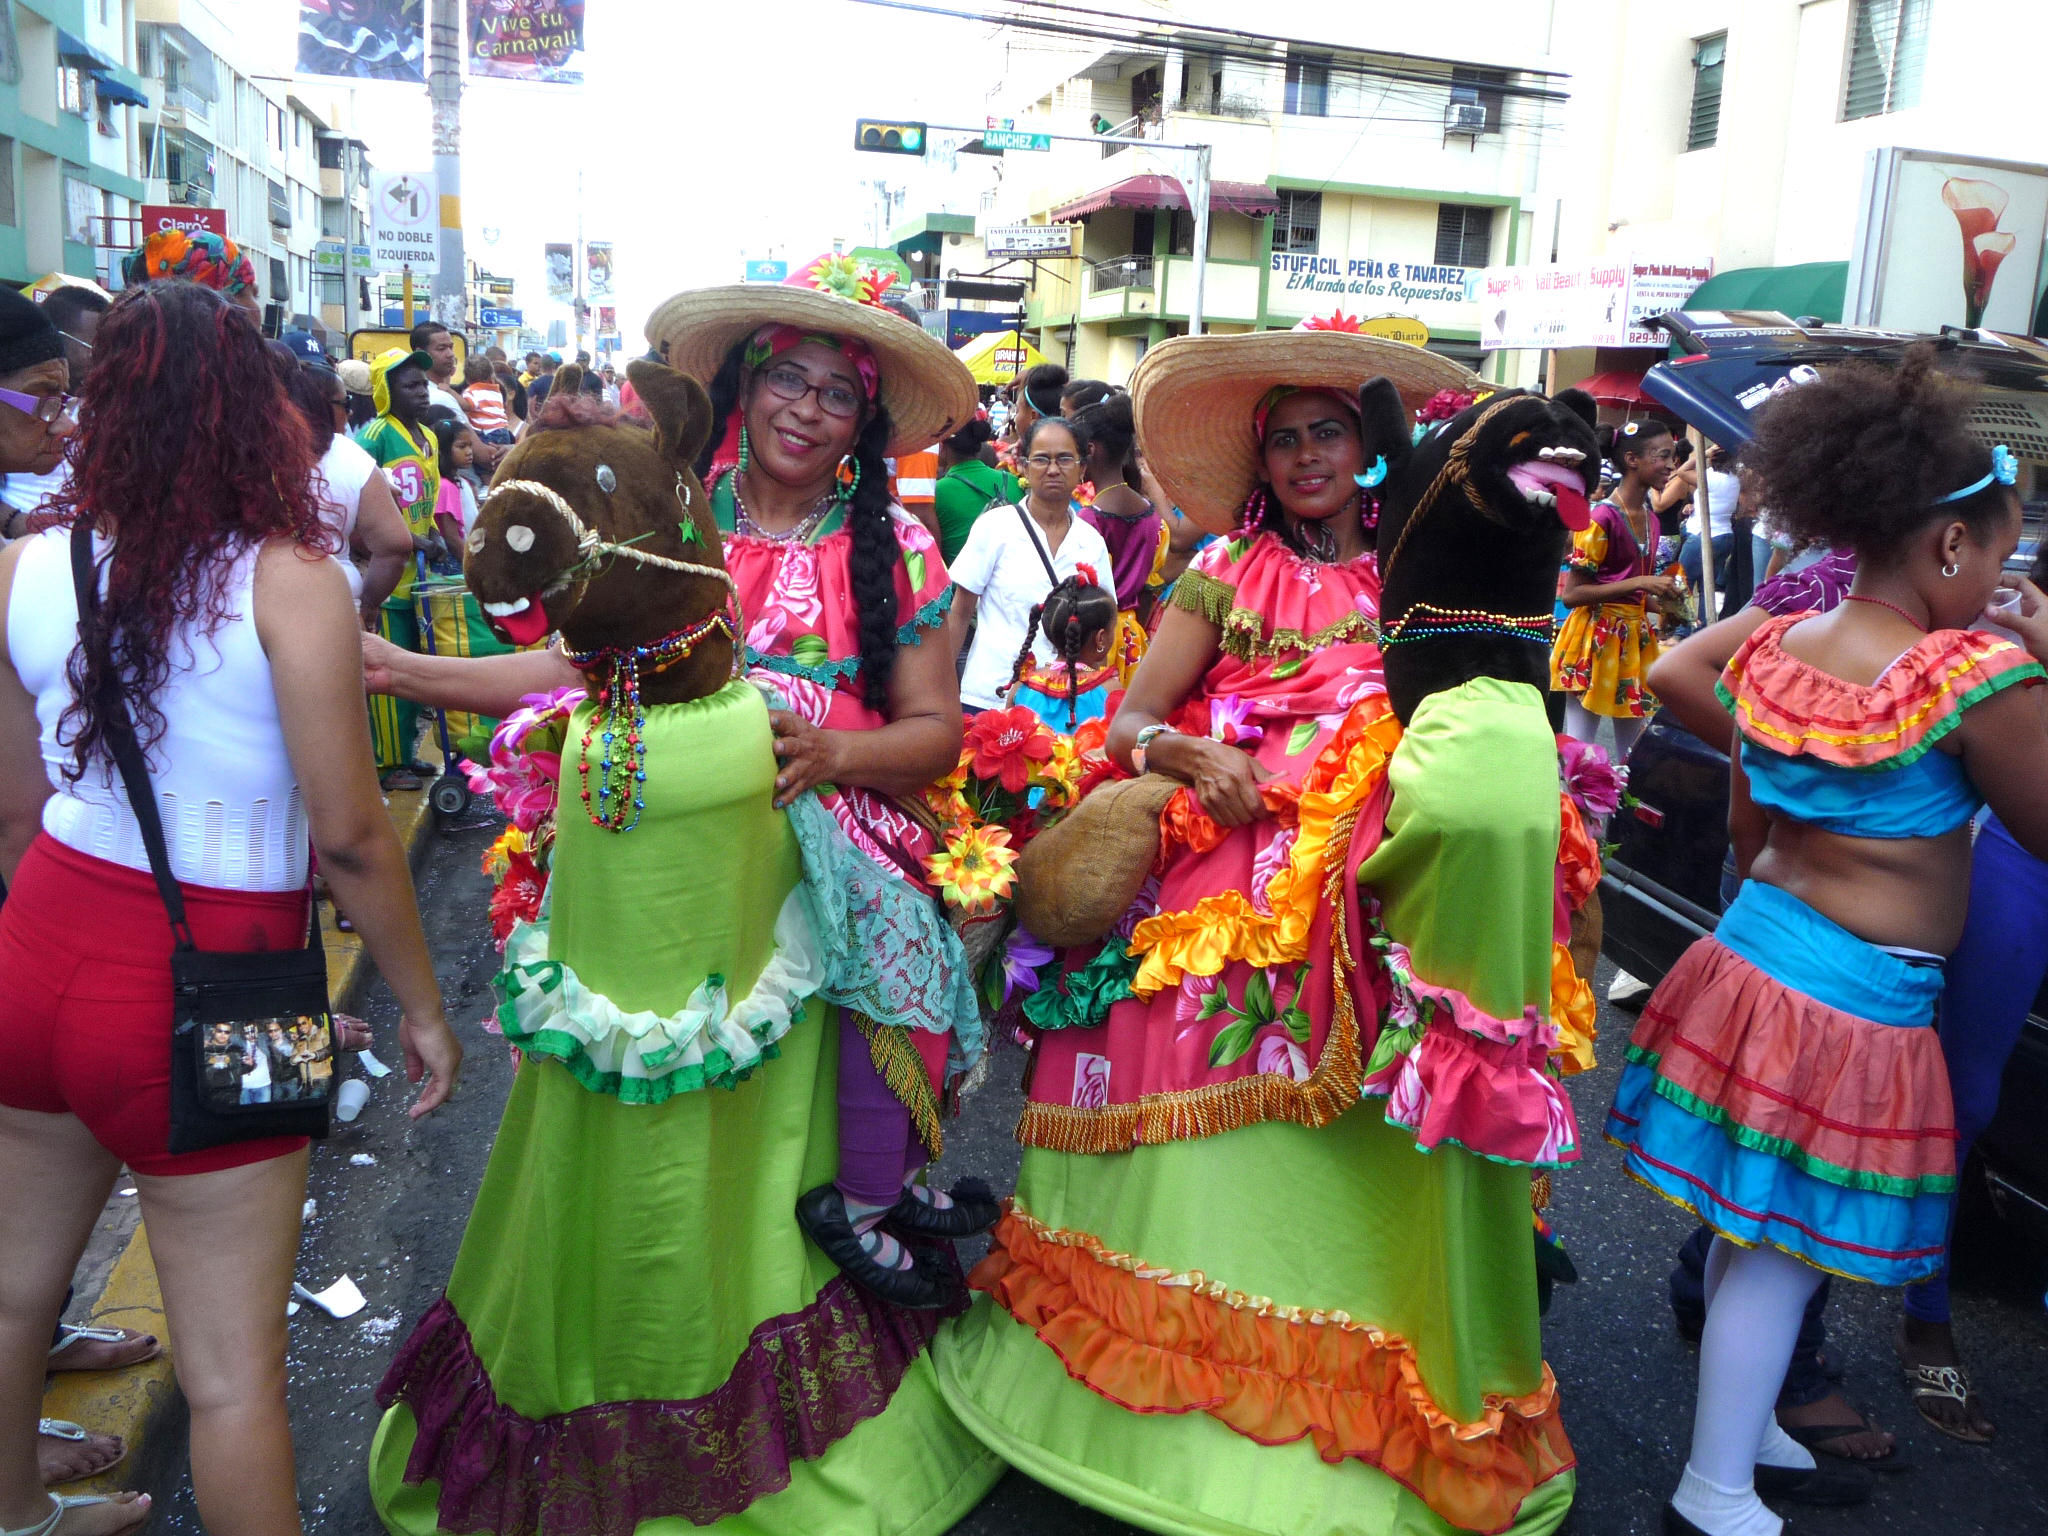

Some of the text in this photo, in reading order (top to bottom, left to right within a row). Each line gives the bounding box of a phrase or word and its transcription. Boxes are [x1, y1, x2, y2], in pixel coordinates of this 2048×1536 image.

[481, 12, 562, 34] Vive tu
[475, 30, 577, 57] Carnaval!
[985, 131, 1033, 148] SANCHEZ
[159, 217, 202, 231] Claro
[378, 230, 433, 243] NO DOBLE
[377, 249, 436, 262] IZQUIERDA
[1271, 254, 1465, 285] STUFACIL PEÑA & TAVAREZ
[1590, 264, 1625, 288] Supply
[1300, 273, 1346, 294] Mundo
[1388, 280, 1463, 305] Repuestos
[482, 311, 498, 324] C3
